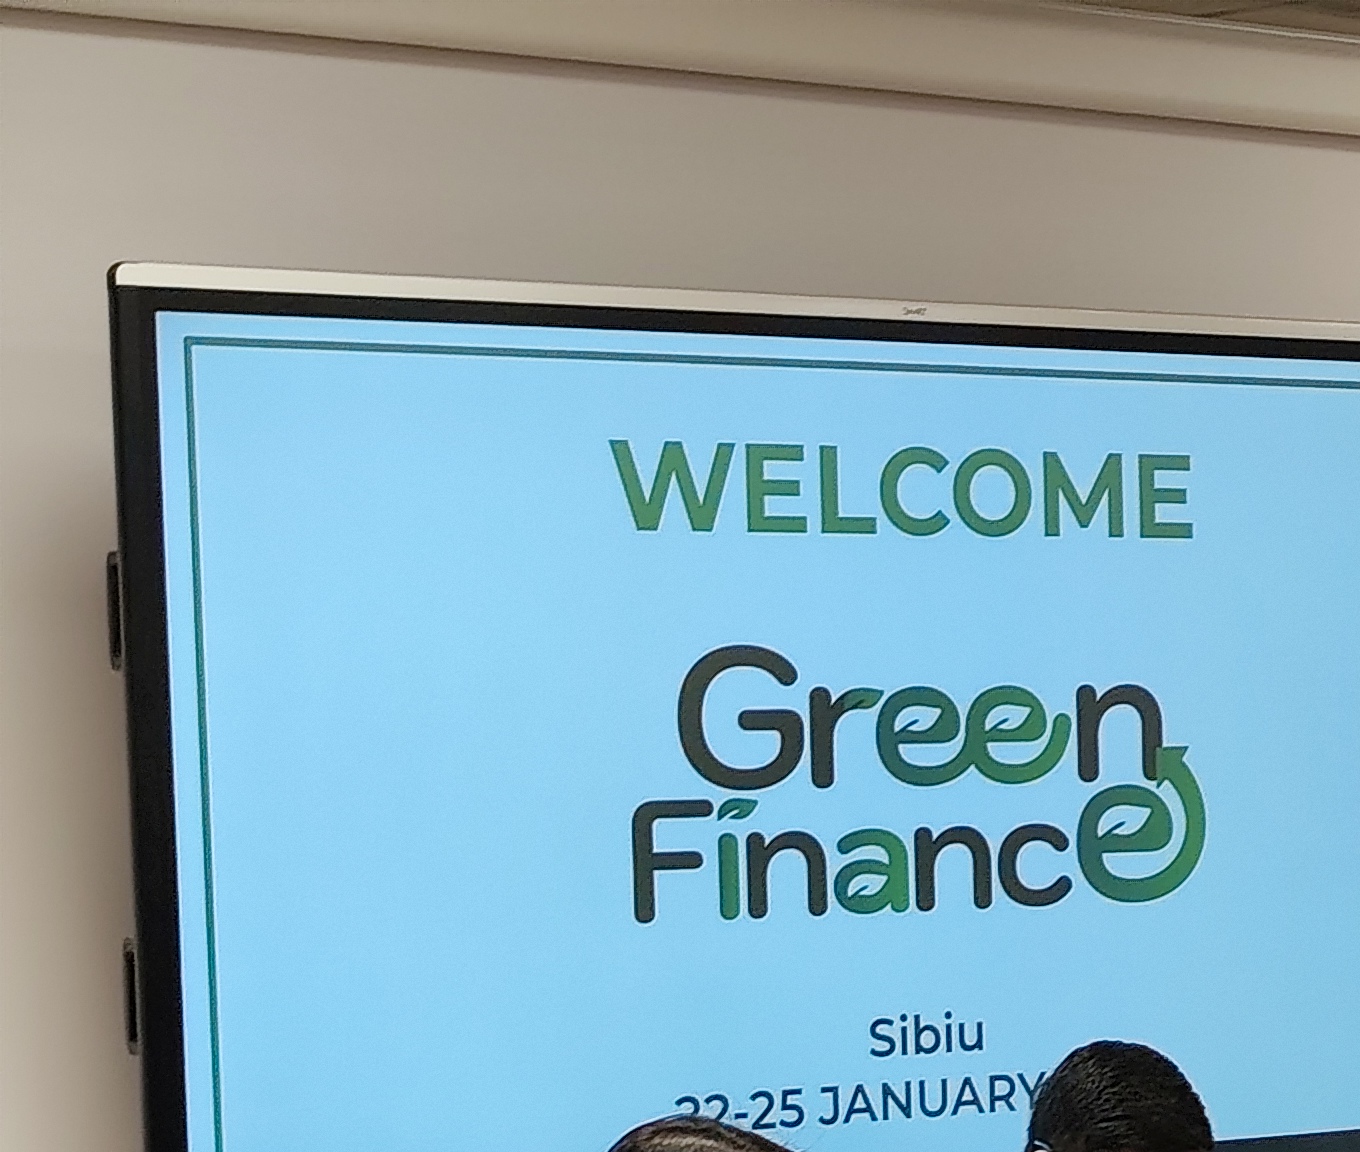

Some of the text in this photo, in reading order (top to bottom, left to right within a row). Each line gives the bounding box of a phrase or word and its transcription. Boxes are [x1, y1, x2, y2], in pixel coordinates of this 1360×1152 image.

[608, 438, 1193, 540] WELCOME
[677, 645, 1163, 790] Green
[632, 745, 1205, 925] Finance
[869, 1010, 985, 1058] Sibiu
[818, 1071, 1046, 1125] JANUARY
